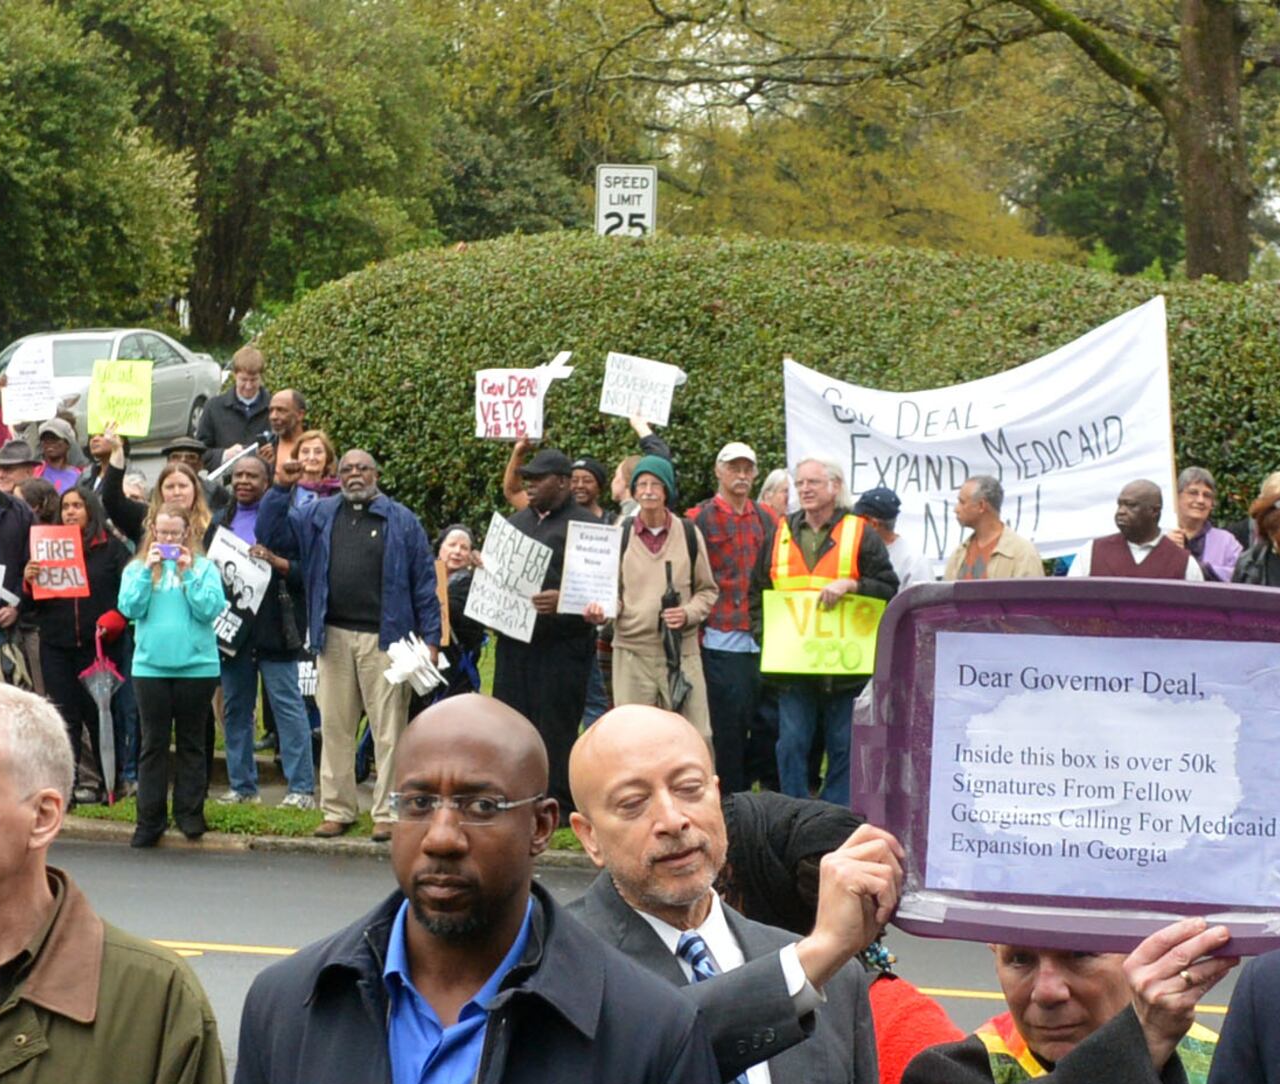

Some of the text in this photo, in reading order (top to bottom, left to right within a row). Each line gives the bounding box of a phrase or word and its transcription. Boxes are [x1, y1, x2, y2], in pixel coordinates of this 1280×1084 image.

[605, 175, 649, 189] SPEED
[609, 193, 643, 206] LIMIT
[604, 211, 647, 236] 25
[611, 355, 632, 371] NO
[605, 389, 626, 407] NO
[607, 371, 671, 399] COVERAGE
[480, 400, 523, 423] VETO
[895, 400, 980, 440] DEAL
[849, 414, 1125, 495] EXPAND MEDICAID
[923, 484, 1041, 560] NW!
[35, 540, 75, 560] FIRE
[491, 518, 551, 567] HEALTH
[576, 543, 611, 556] Medicaid
[579, 531, 609, 543] Expand
[38, 566, 85, 588] DEAL
[522, 556, 548, 587] FOR
[471, 582, 531, 621] MONDAY
[471, 600, 529, 630] GEORGIA
[784, 596, 877, 638] VETO
[958, 664, 1206, 699] Dear Governor Deal,
[954, 743, 1218, 773] Inside this box is over 50k
[952, 774, 1192, 803] Signatures From Fellow
[951, 803, 1277, 838] Georgians Calling For Medicaid
[950, 832, 1168, 867] Expansion In Georgia
